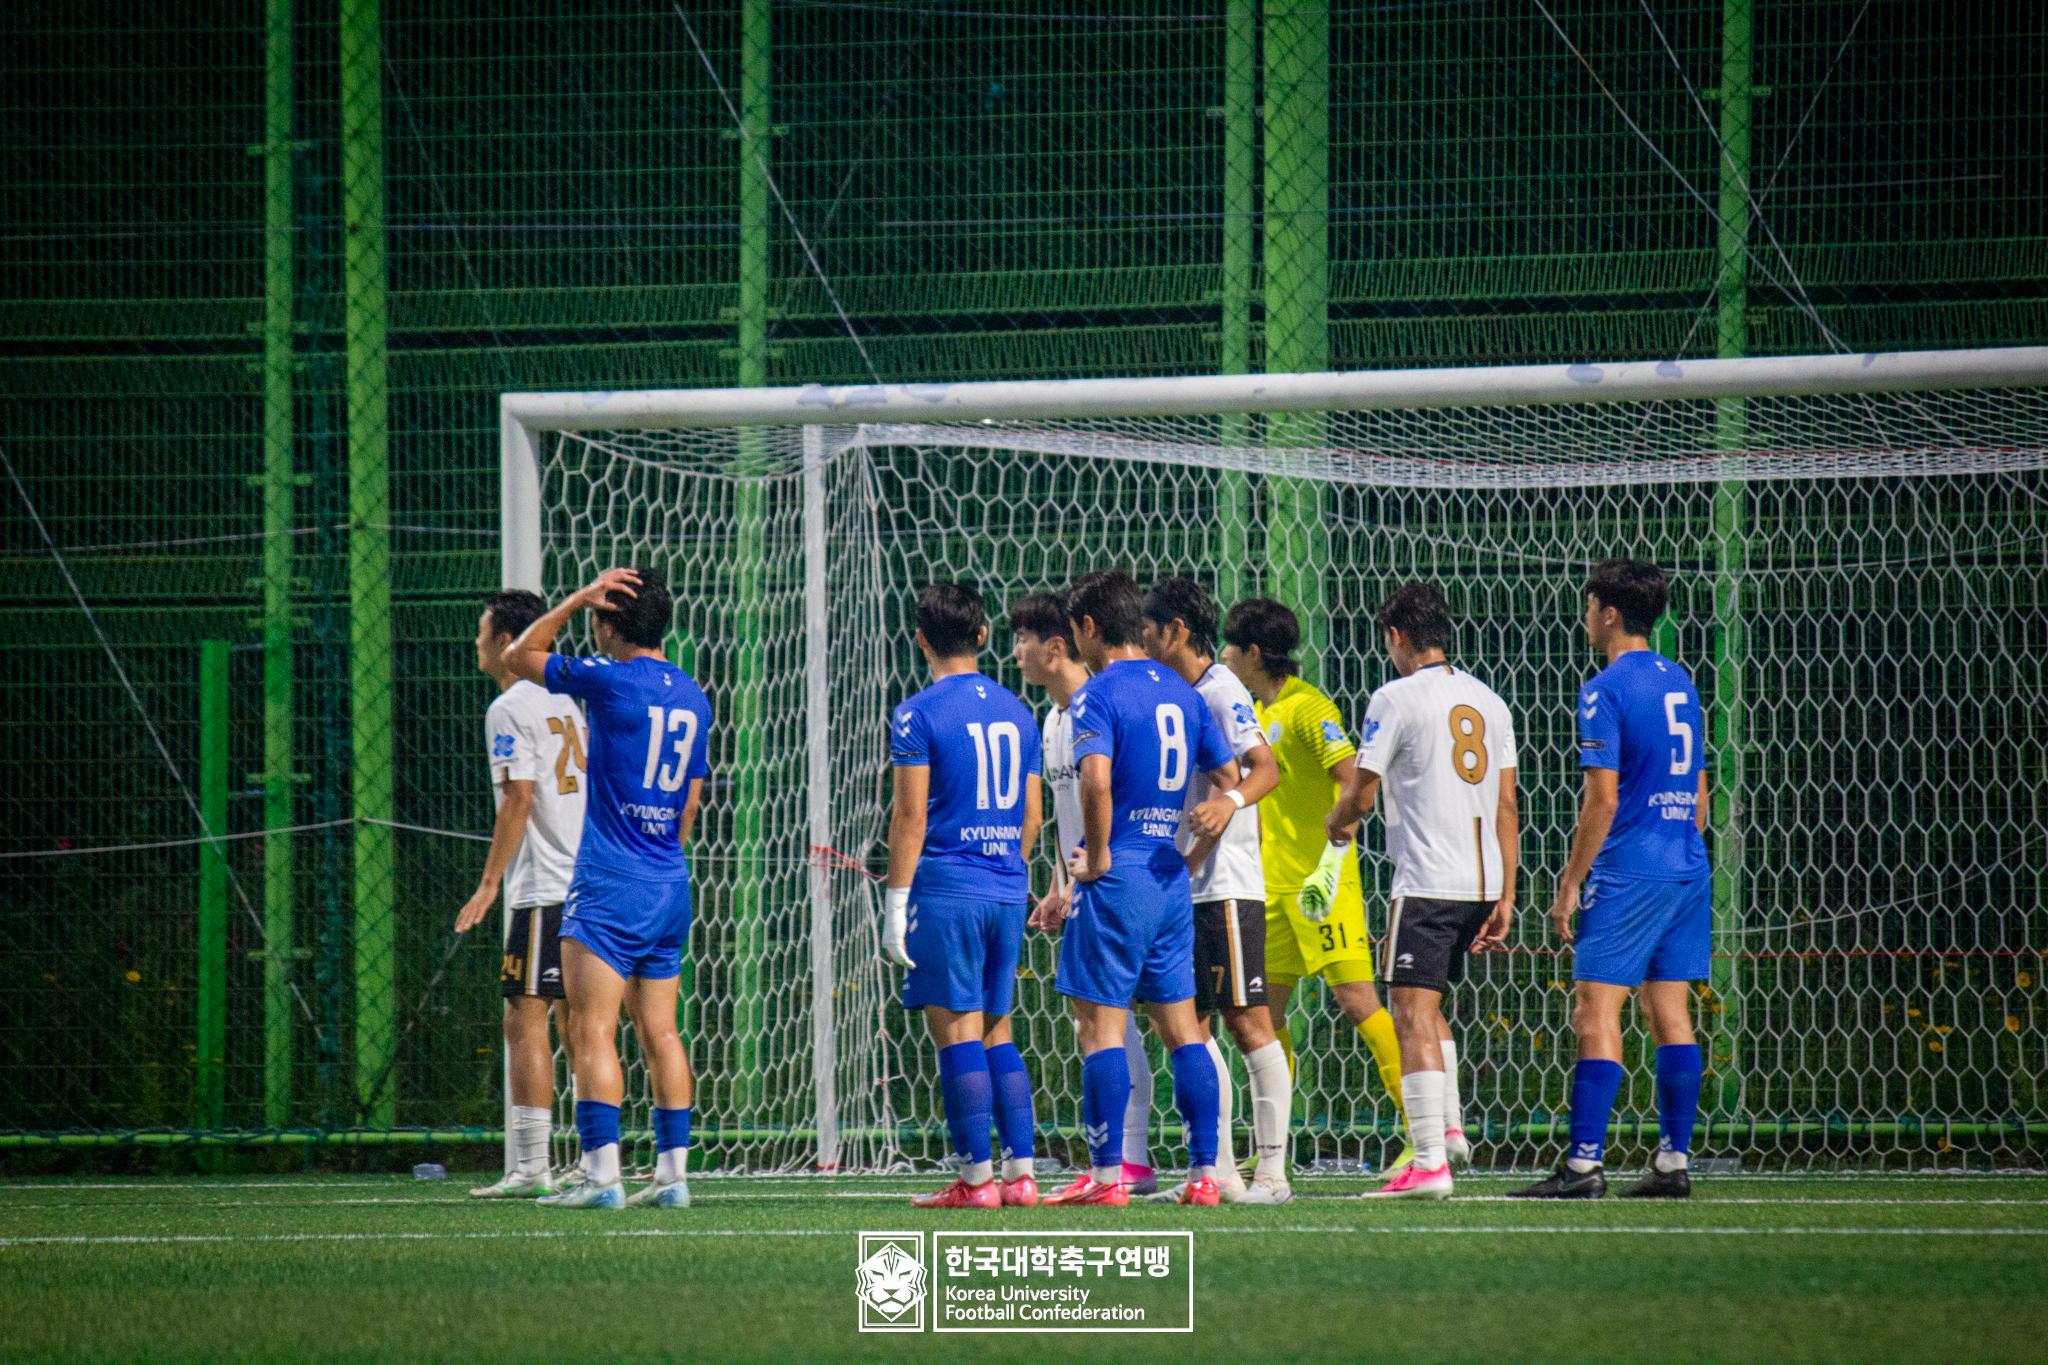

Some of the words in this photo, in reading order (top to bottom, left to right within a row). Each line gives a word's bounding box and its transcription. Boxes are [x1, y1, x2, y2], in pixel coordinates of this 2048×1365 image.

[643, 706, 698, 792] 13
[966, 721, 1021, 810] 10
[1155, 703, 1188, 791] 8
[1449, 704, 1488, 785] 8
[1664, 692, 1693, 776] 5
[1319, 922, 1346, 952] 31
[1210, 965, 1225, 995] 7
